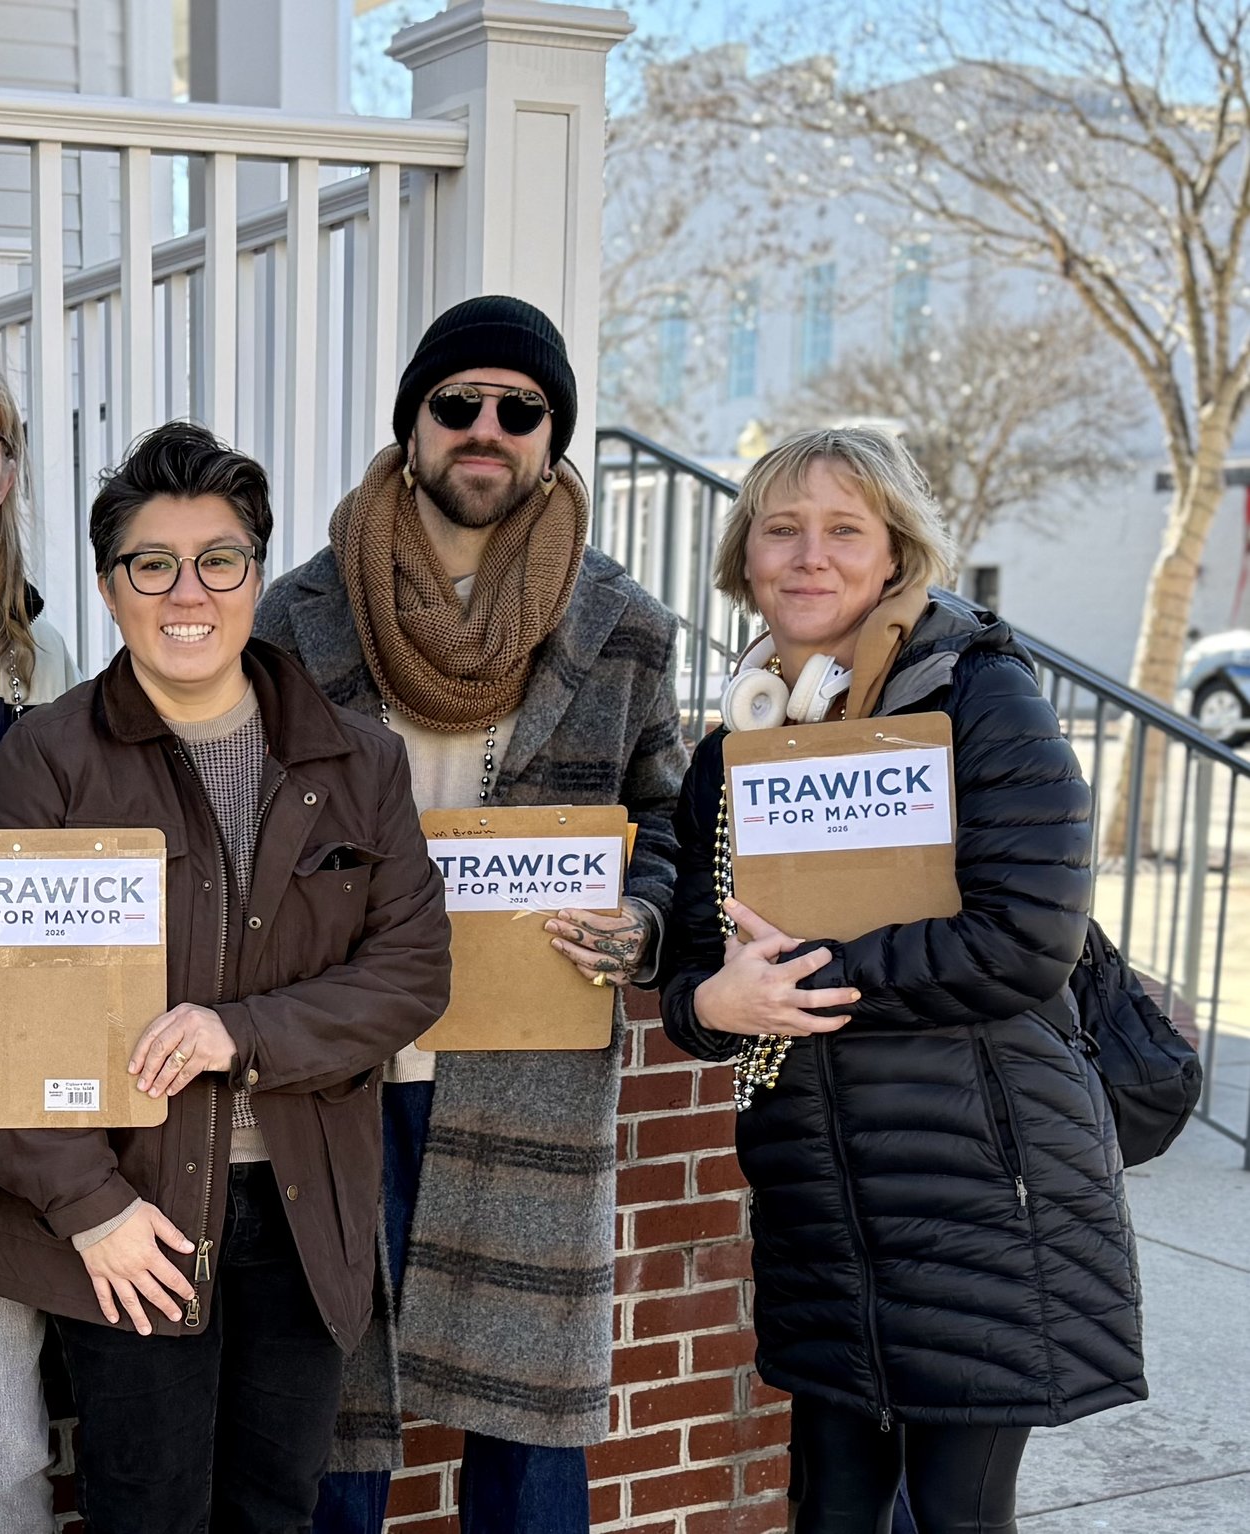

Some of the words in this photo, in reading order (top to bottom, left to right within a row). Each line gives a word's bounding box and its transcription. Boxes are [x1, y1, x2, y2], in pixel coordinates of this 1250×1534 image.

[743, 765, 932, 806] TRAWICK
[769, 808, 814, 825] FOR
[825, 801, 908, 822] MAYOR
[452, 828, 496, 837] Brown
[827, 825, 849, 833] 2026
[436, 852, 607, 878] TRAWICK
[458, 883, 499, 895] FOR
[509, 881, 582, 894] MAYOR
[45, 910, 121, 924] MAYOR
